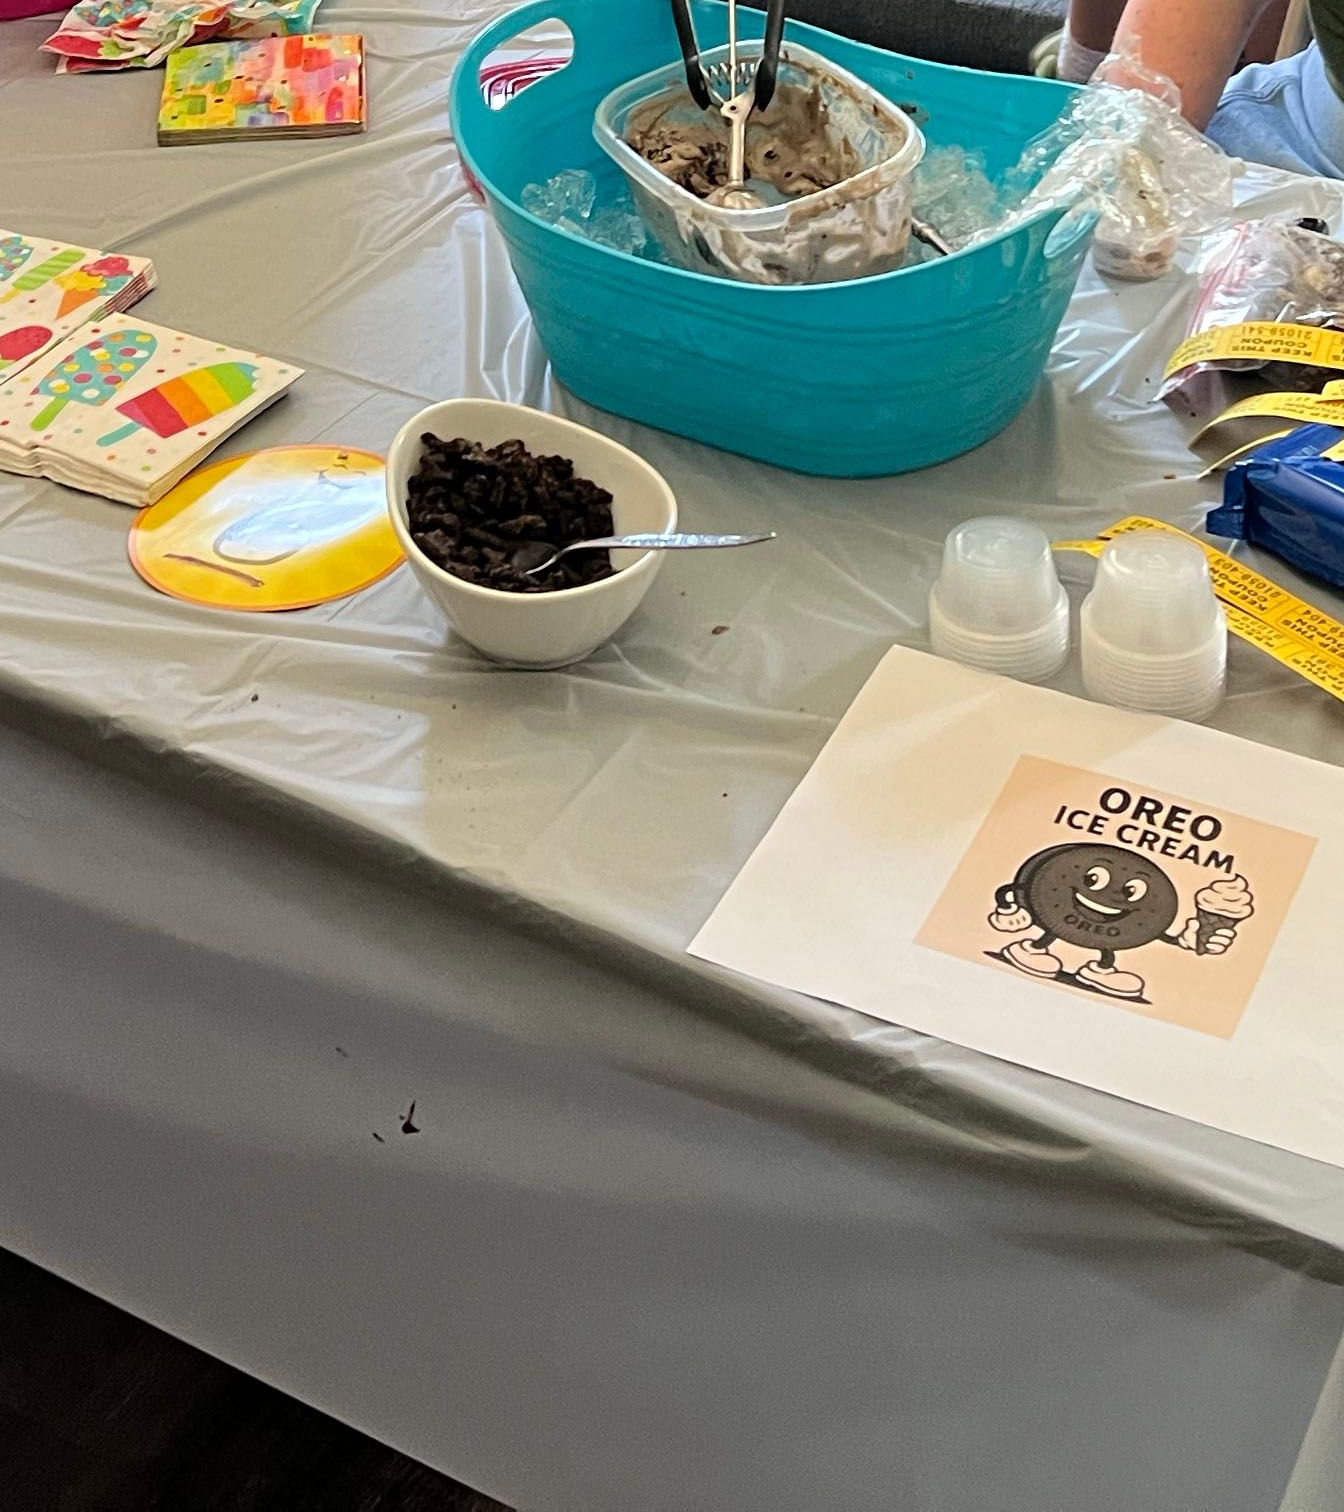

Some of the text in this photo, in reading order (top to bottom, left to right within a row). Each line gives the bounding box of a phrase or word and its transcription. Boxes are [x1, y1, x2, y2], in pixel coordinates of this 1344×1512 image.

[1241, 338, 1307, 348] COUPON
[1271, 347, 1312, 357] KEEP
[1228, 590, 1268, 612] KEEP
[1099, 787, 1222, 842] OREO
[1054, 805, 1235, 874] ICE CREAM
[1063, 913, 1121, 937] OREO
